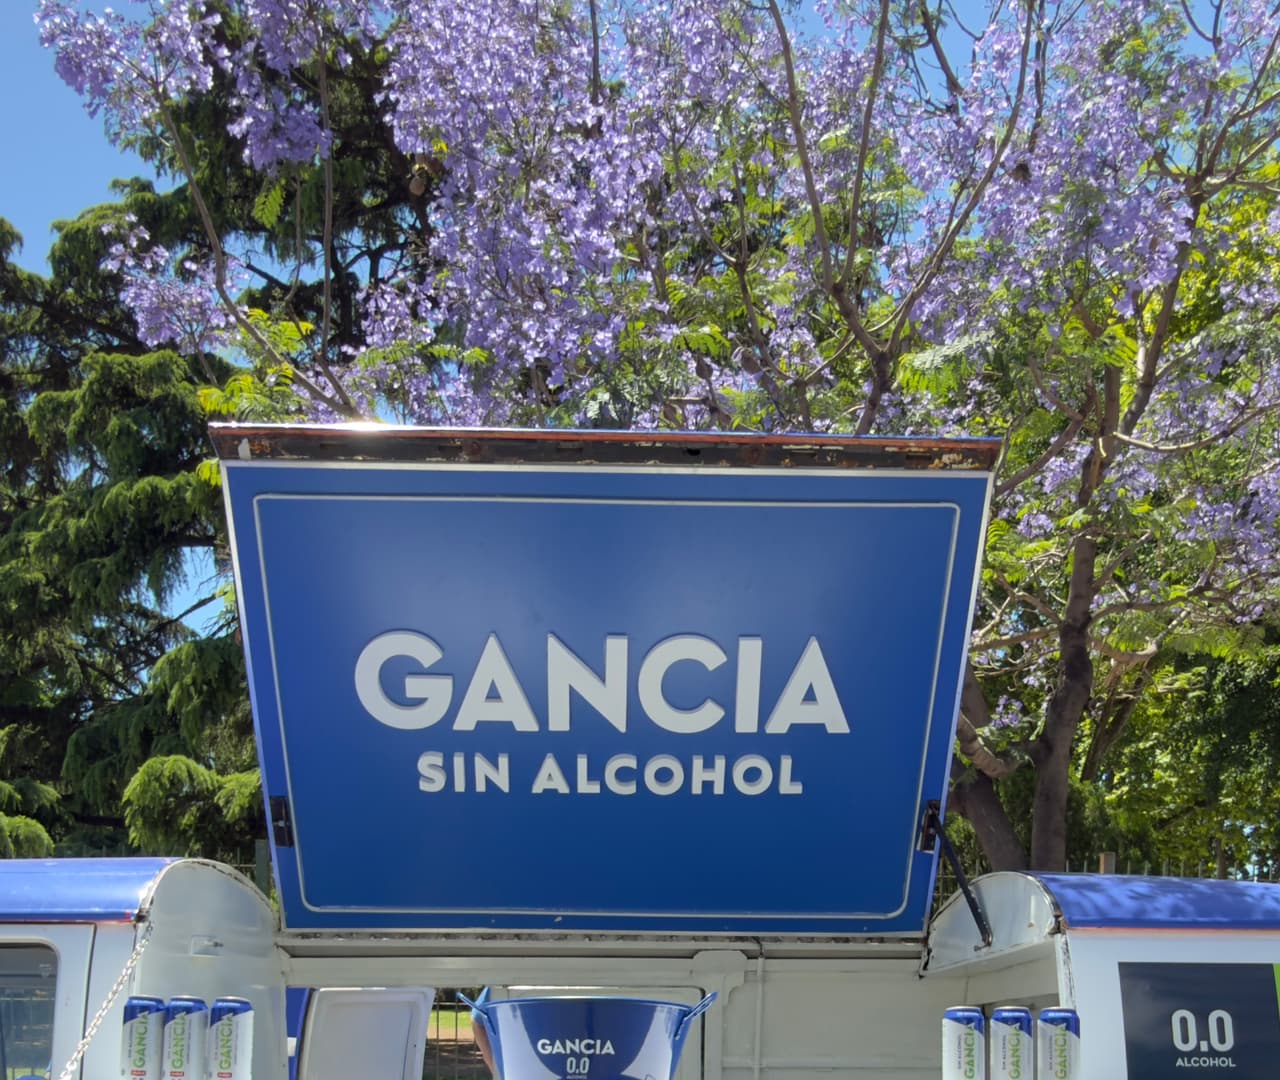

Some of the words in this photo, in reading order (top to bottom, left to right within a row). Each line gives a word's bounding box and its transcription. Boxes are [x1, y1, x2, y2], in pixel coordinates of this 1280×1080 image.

[354, 630, 851, 735] GANCIA
[417, 751, 511, 794] SIN
[531, 753, 804, 797] ALCOHOL
[537, 1038, 615, 1055] GANCIA
[964, 1022, 975, 1079] GANCIA
[1008, 1022, 1021, 1079] GANCIA
[1055, 1022, 1067, 1079] GANCIA
[1170, 1009, 1235, 1052] 0.0
[566, 1056, 590, 1074] 0.0
[1175, 1056, 1237, 1068] ALCOHOL
